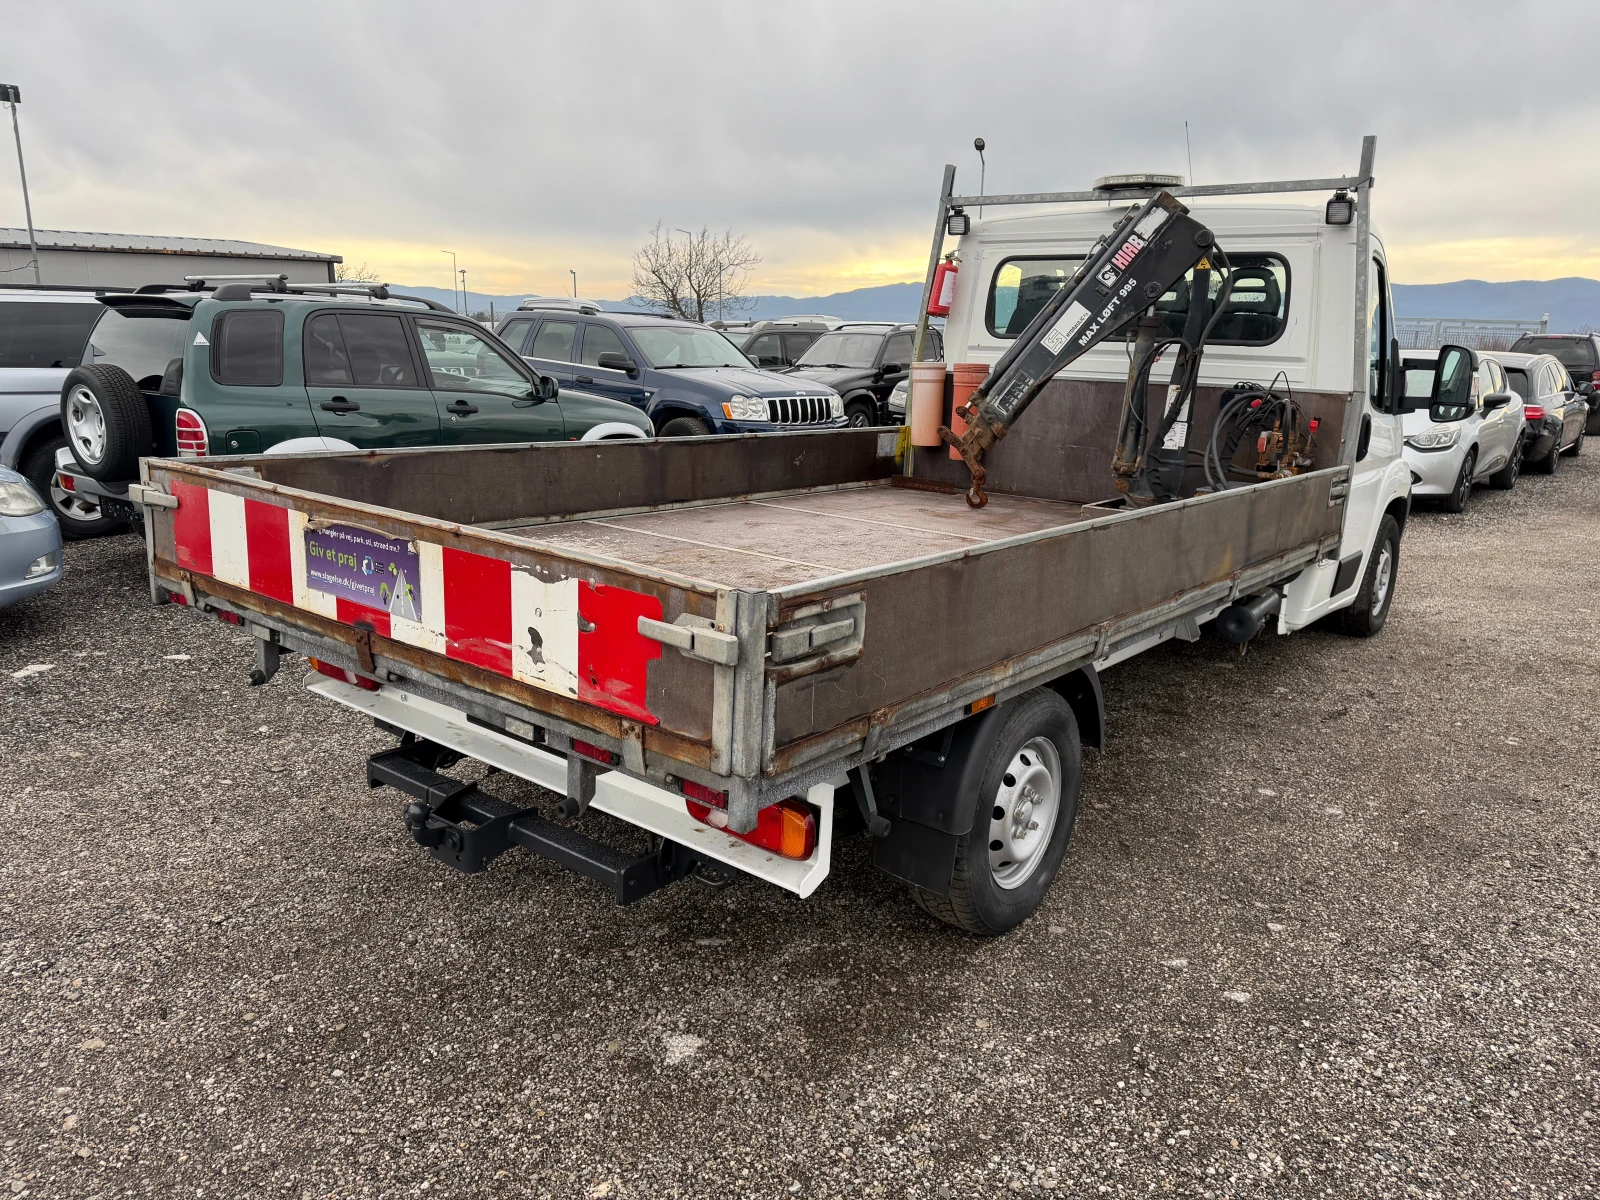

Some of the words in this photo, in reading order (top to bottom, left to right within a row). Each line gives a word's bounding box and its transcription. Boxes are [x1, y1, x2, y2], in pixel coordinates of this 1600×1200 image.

[1111, 234, 1144, 270] HIAB
[1066, 315, 1086, 338] HYDRAULIC
[1078, 322, 1101, 347] MAX
[1097, 296, 1121, 324] LØFT
[1119, 277, 1137, 297] 995
[322, 528, 339, 539] mangler
[339, 531, 345, 541] på
[373, 541, 389, 551] strand
[309, 540, 324, 559] Giv
[326, 548, 336, 562] et
[338, 552, 357, 572] praj
[310, 569, 375, 597] www.slagelse.dk/givetpraj
